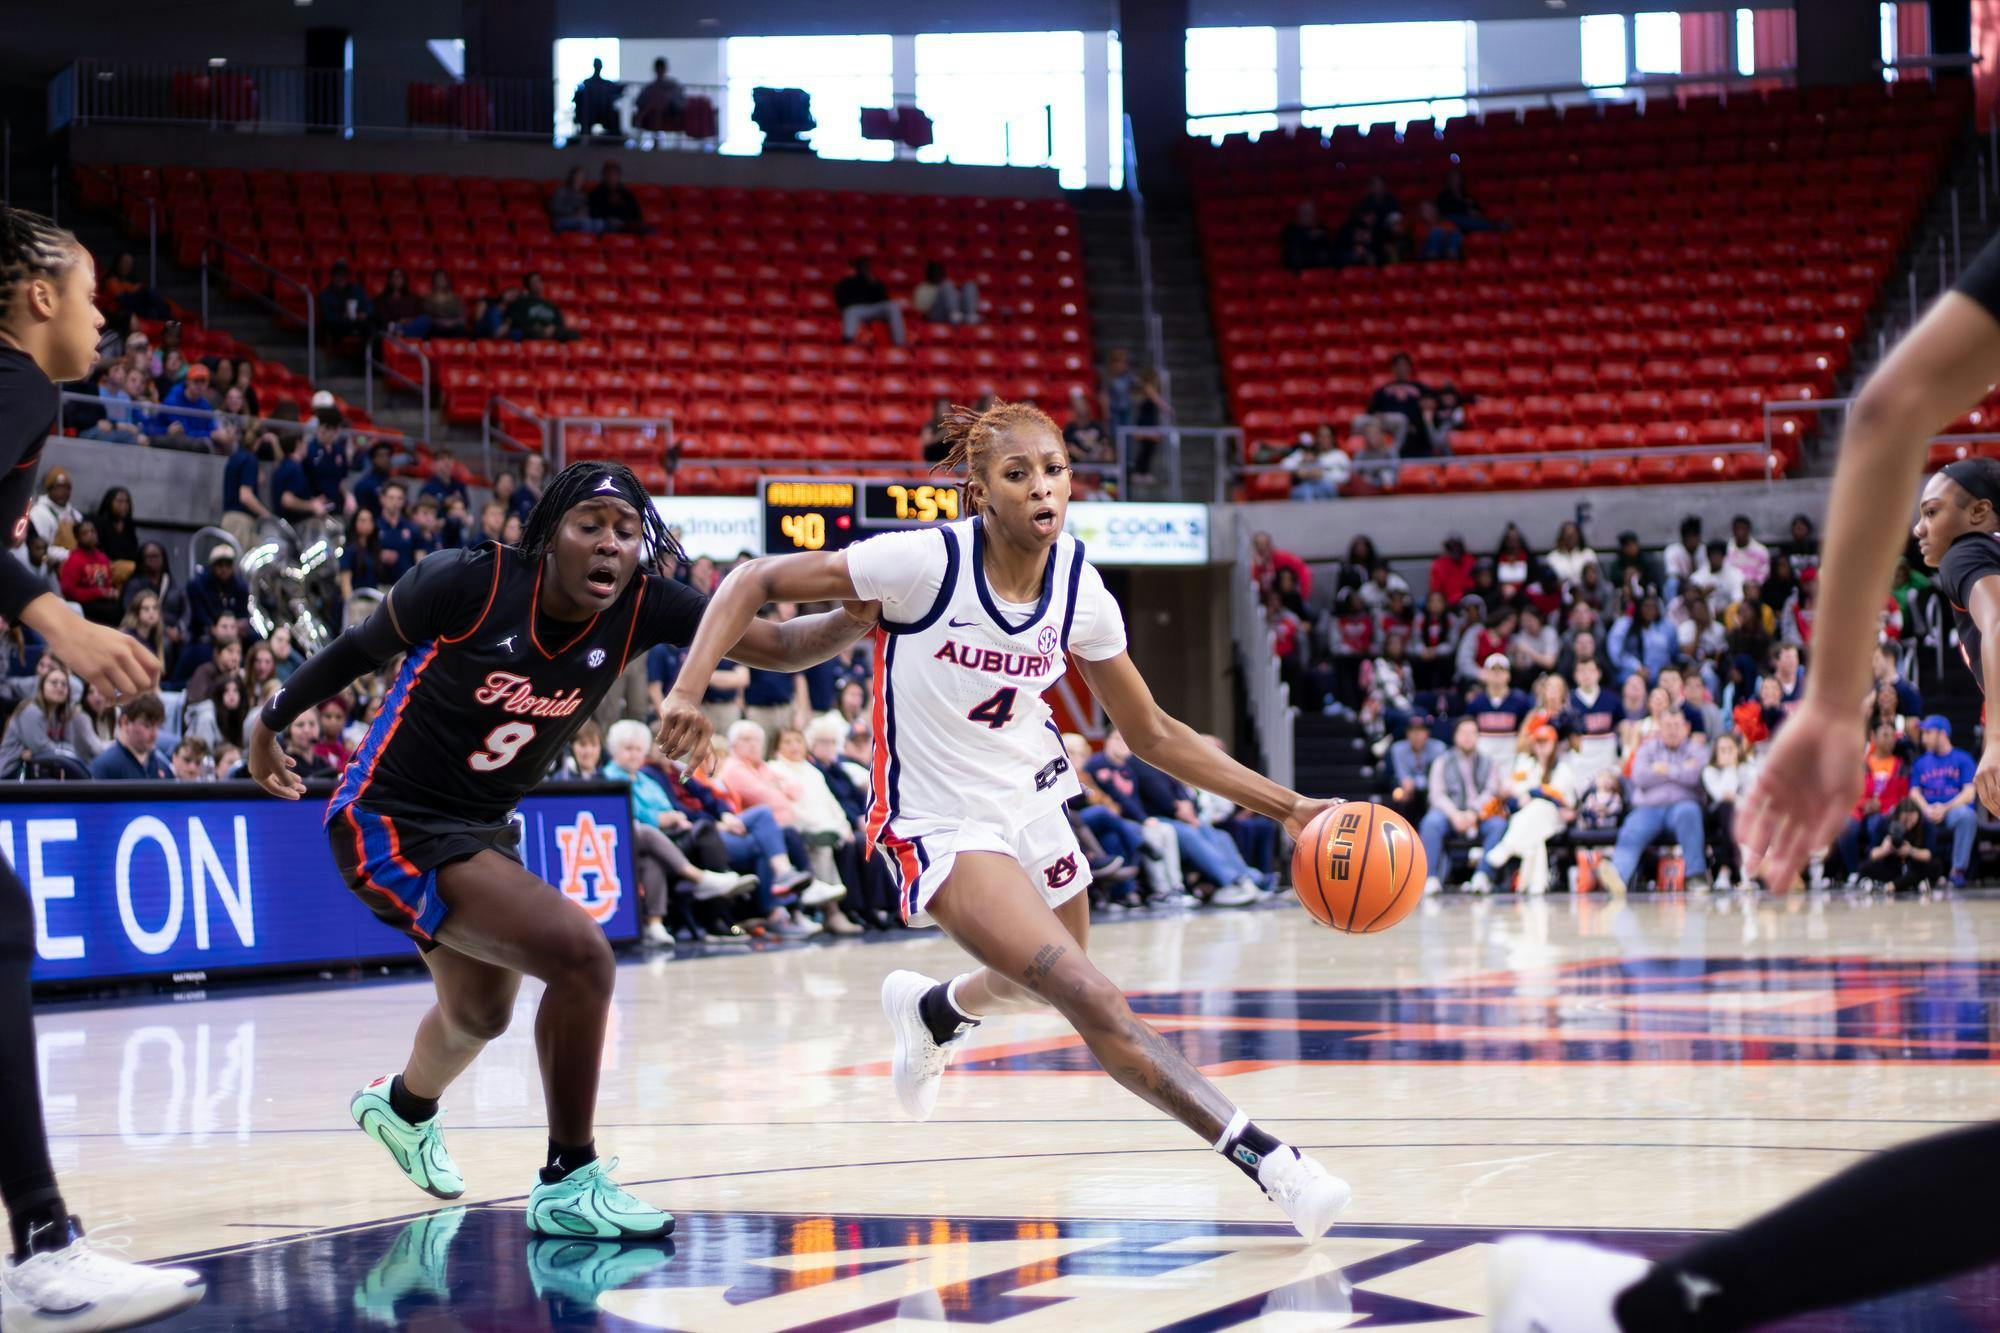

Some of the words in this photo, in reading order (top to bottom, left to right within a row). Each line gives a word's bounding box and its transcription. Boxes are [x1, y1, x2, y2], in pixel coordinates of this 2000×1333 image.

[886, 485, 958, 522] 7:54
[781, 512, 825, 550] 40
[934, 640, 1054, 678] AUBURN
[474, 671, 584, 718] Florida
[968, 686, 1019, 729] 4
[467, 720, 537, 773] 9
[1330, 813, 1362, 881] ELITE
[115, 814, 256, 956] ON
